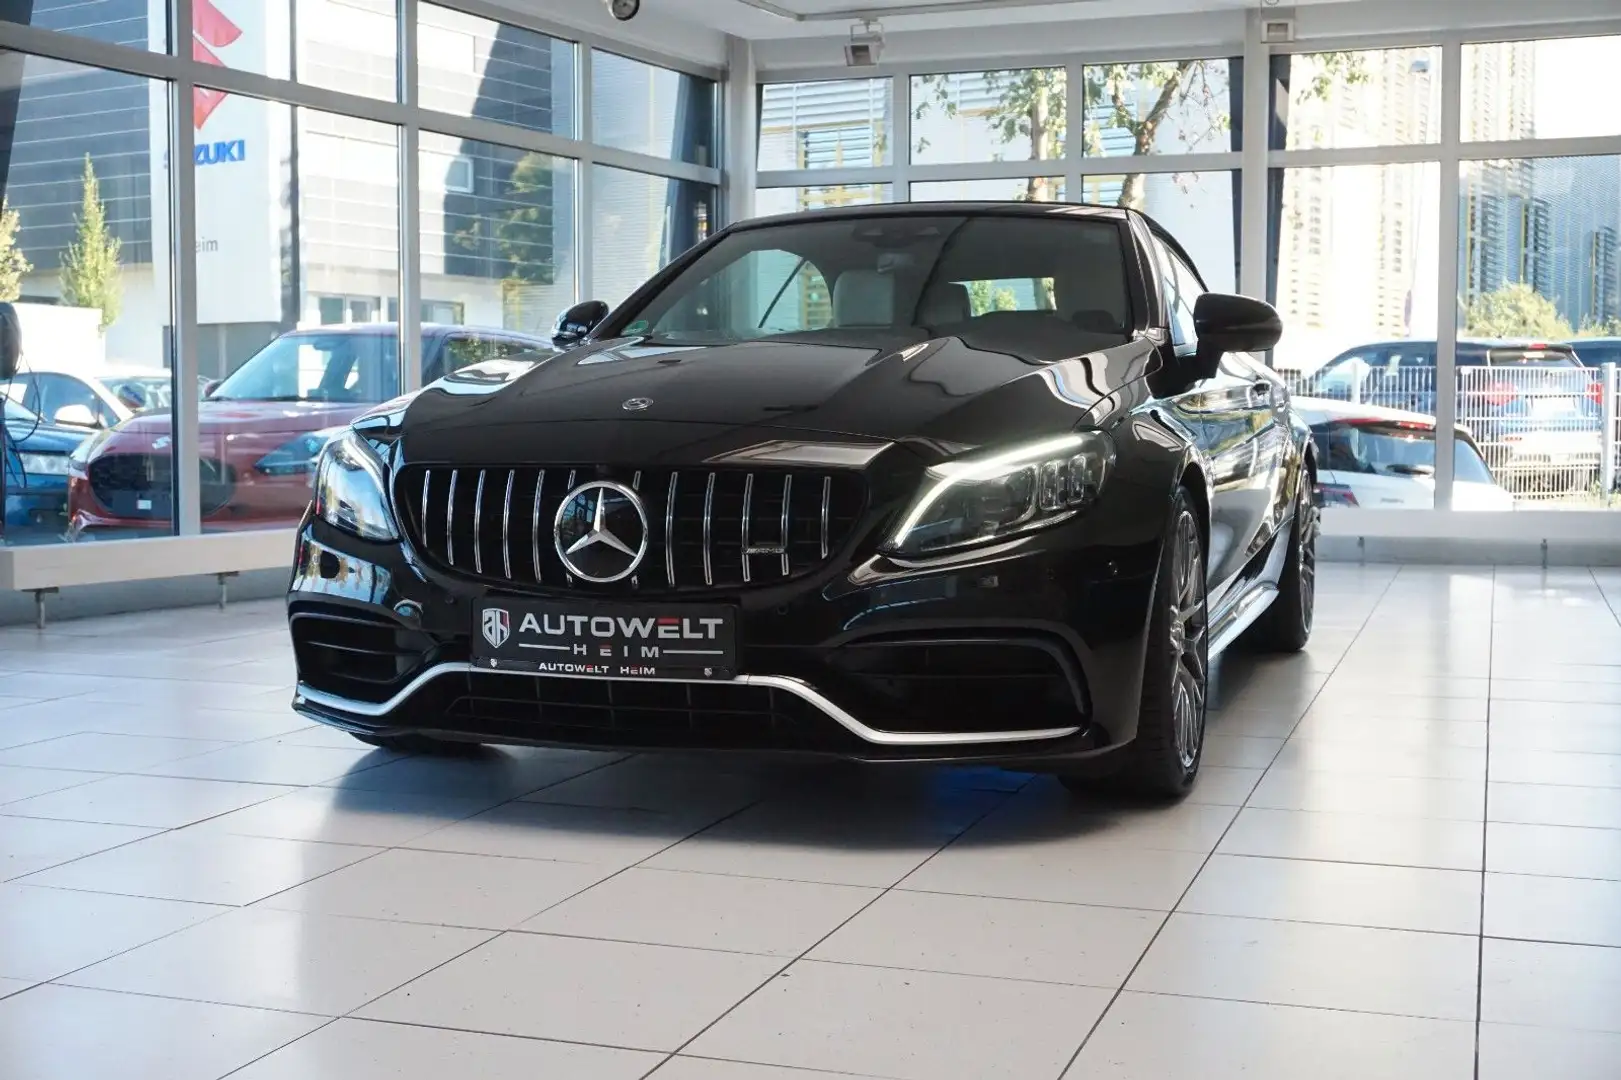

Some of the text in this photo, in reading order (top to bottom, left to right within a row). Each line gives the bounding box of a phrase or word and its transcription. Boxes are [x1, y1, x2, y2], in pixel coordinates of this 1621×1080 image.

[518, 612, 724, 640] AUTOWELT
[573, 643, 659, 658] HEIM
[538, 662, 656, 675] AUTOWELT HEIM
